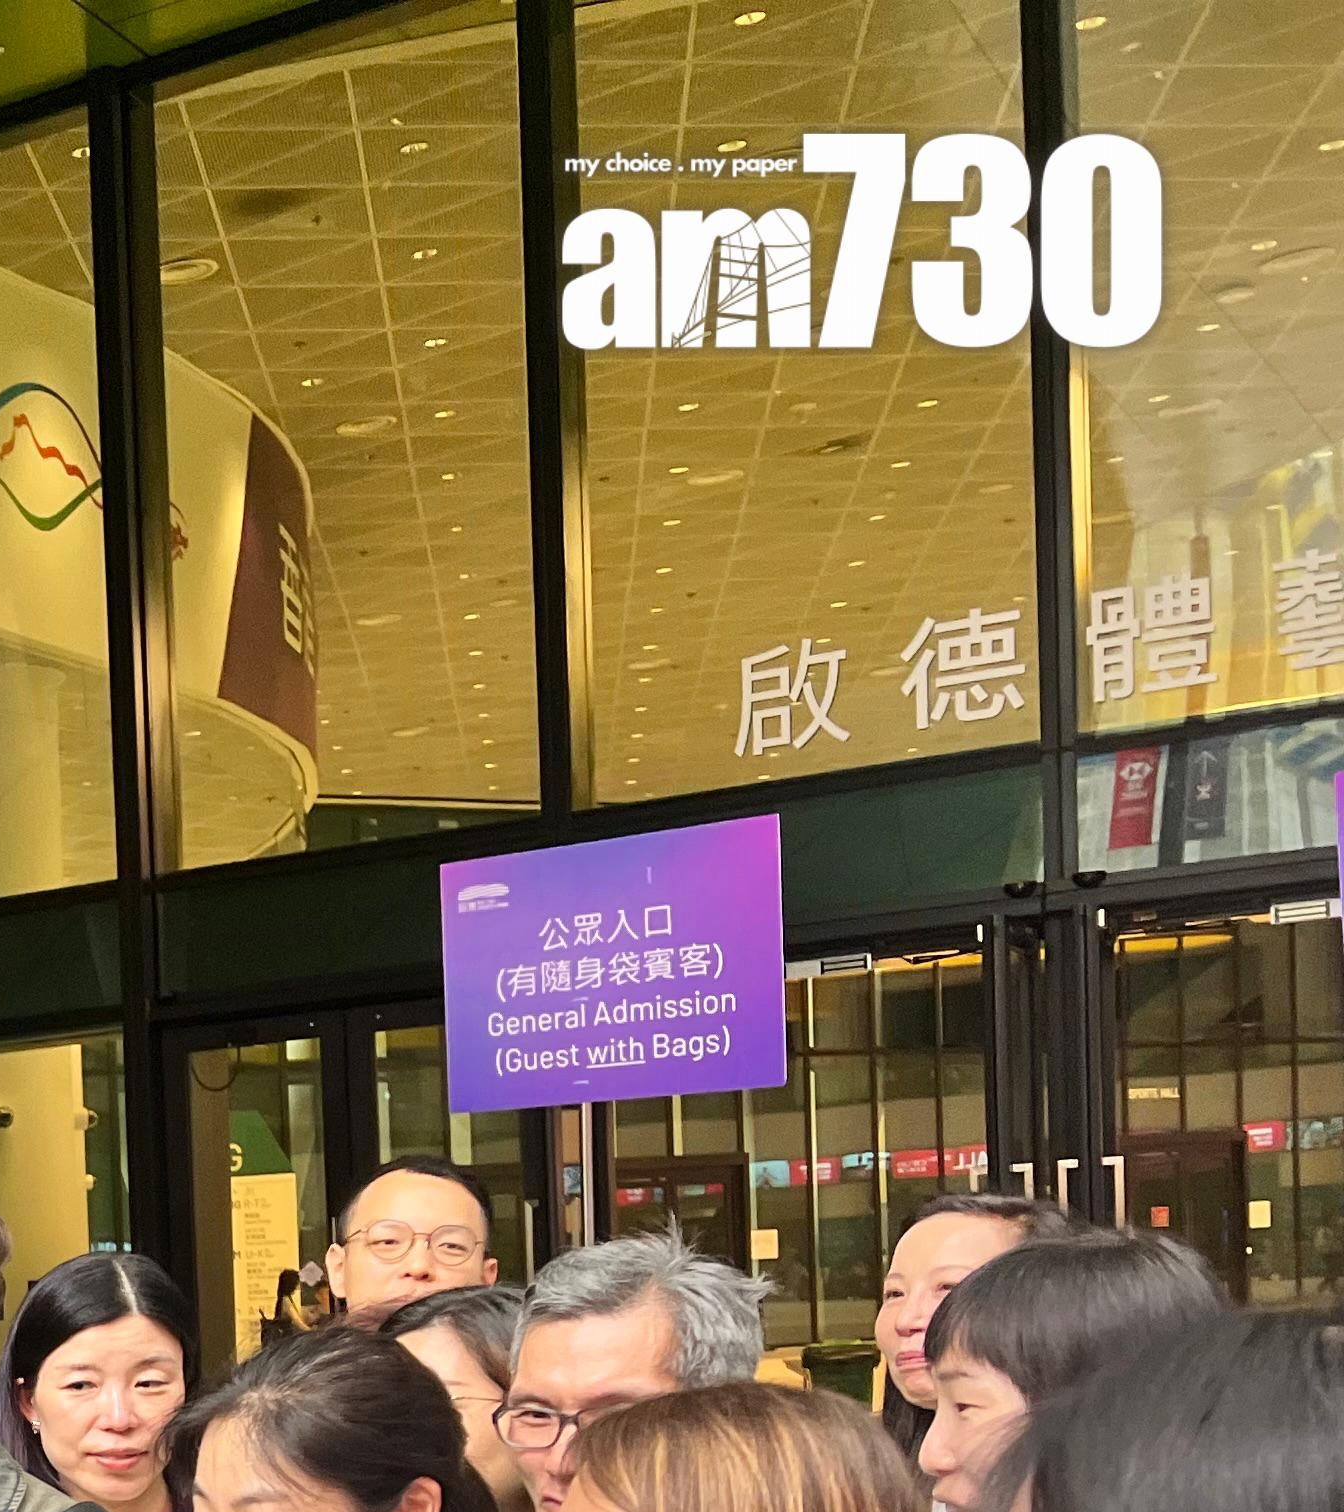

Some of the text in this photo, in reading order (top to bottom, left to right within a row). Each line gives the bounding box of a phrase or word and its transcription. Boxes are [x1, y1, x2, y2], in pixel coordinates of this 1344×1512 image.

[538, 904, 673, 951] 公眾入口
[496, 943, 724, 1003] (有隨身袋賓客)
[487, 991, 737, 1038] General Admission
[495, 1025, 732, 1077] (Guest with Bags)
